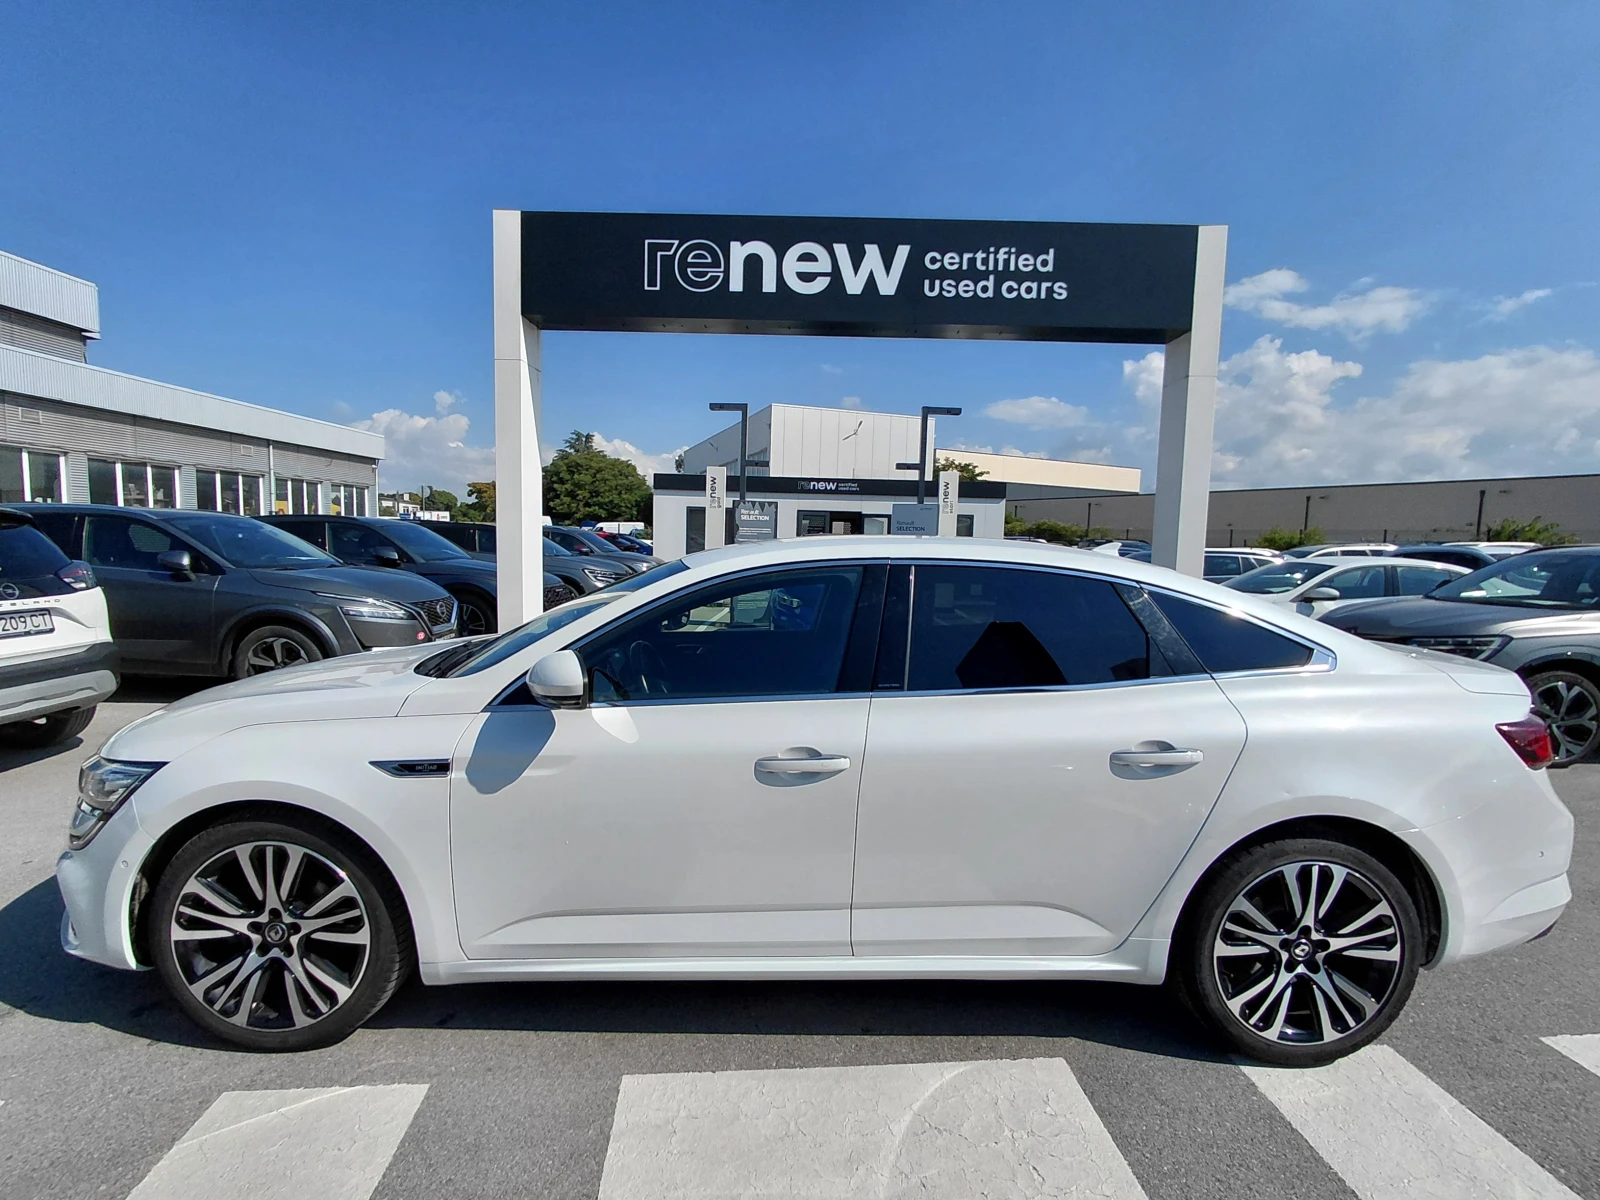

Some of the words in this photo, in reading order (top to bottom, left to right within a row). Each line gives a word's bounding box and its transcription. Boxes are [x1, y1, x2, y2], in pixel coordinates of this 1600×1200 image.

[644, 239, 911, 296] renew
[924, 246, 1055, 273] certified
[923, 274, 995, 298] used
[1001, 280, 1068, 300] cars
[797, 481, 837, 490] renew
[942, 481, 950, 514] renew
